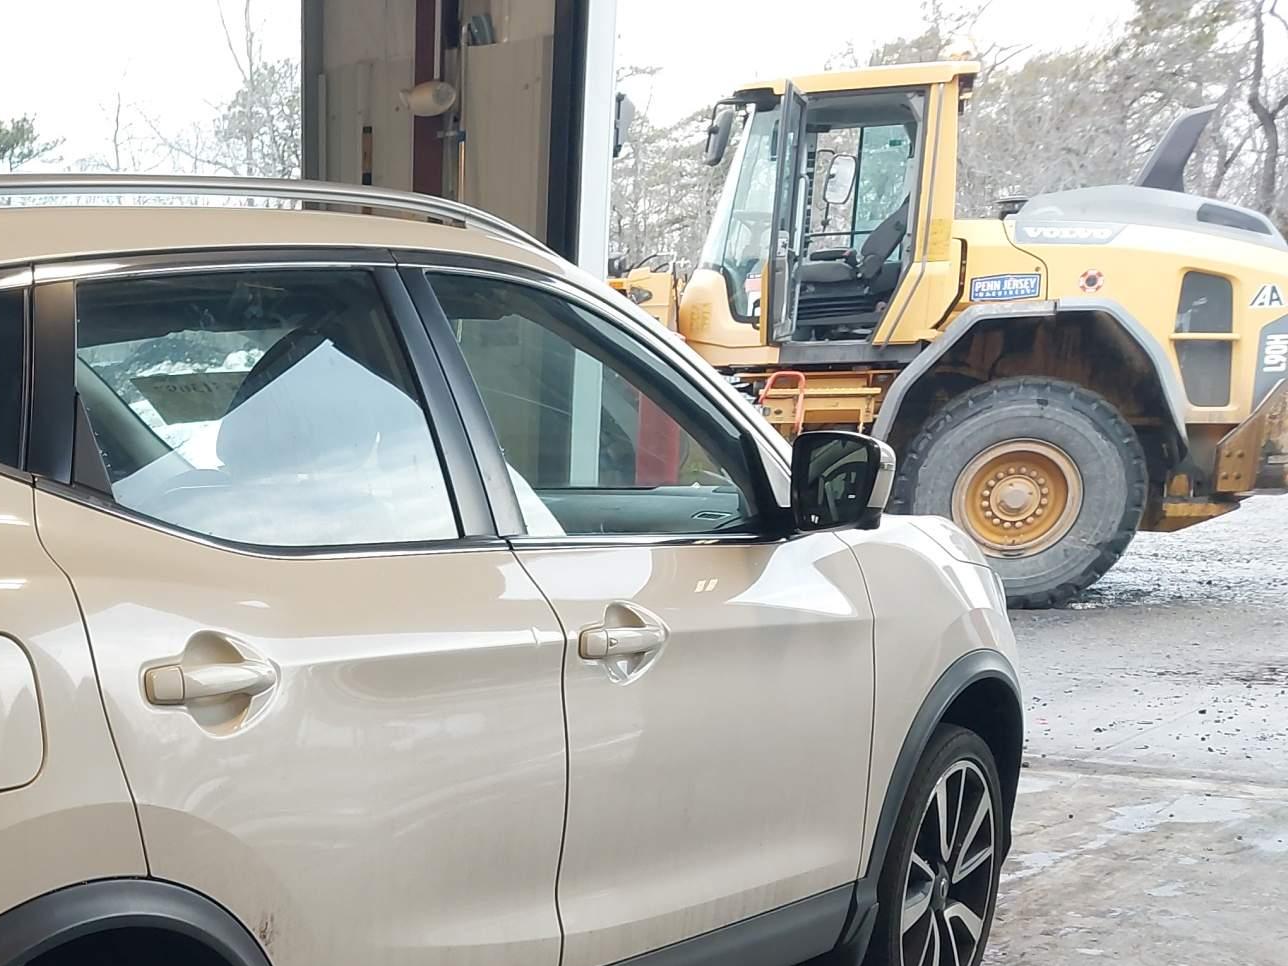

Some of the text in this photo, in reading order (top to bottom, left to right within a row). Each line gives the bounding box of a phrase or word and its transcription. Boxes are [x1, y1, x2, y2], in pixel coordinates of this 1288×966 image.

[1023, 226, 1113, 240] VOLVO
[974, 277, 1037, 292] PENN JERSEY
